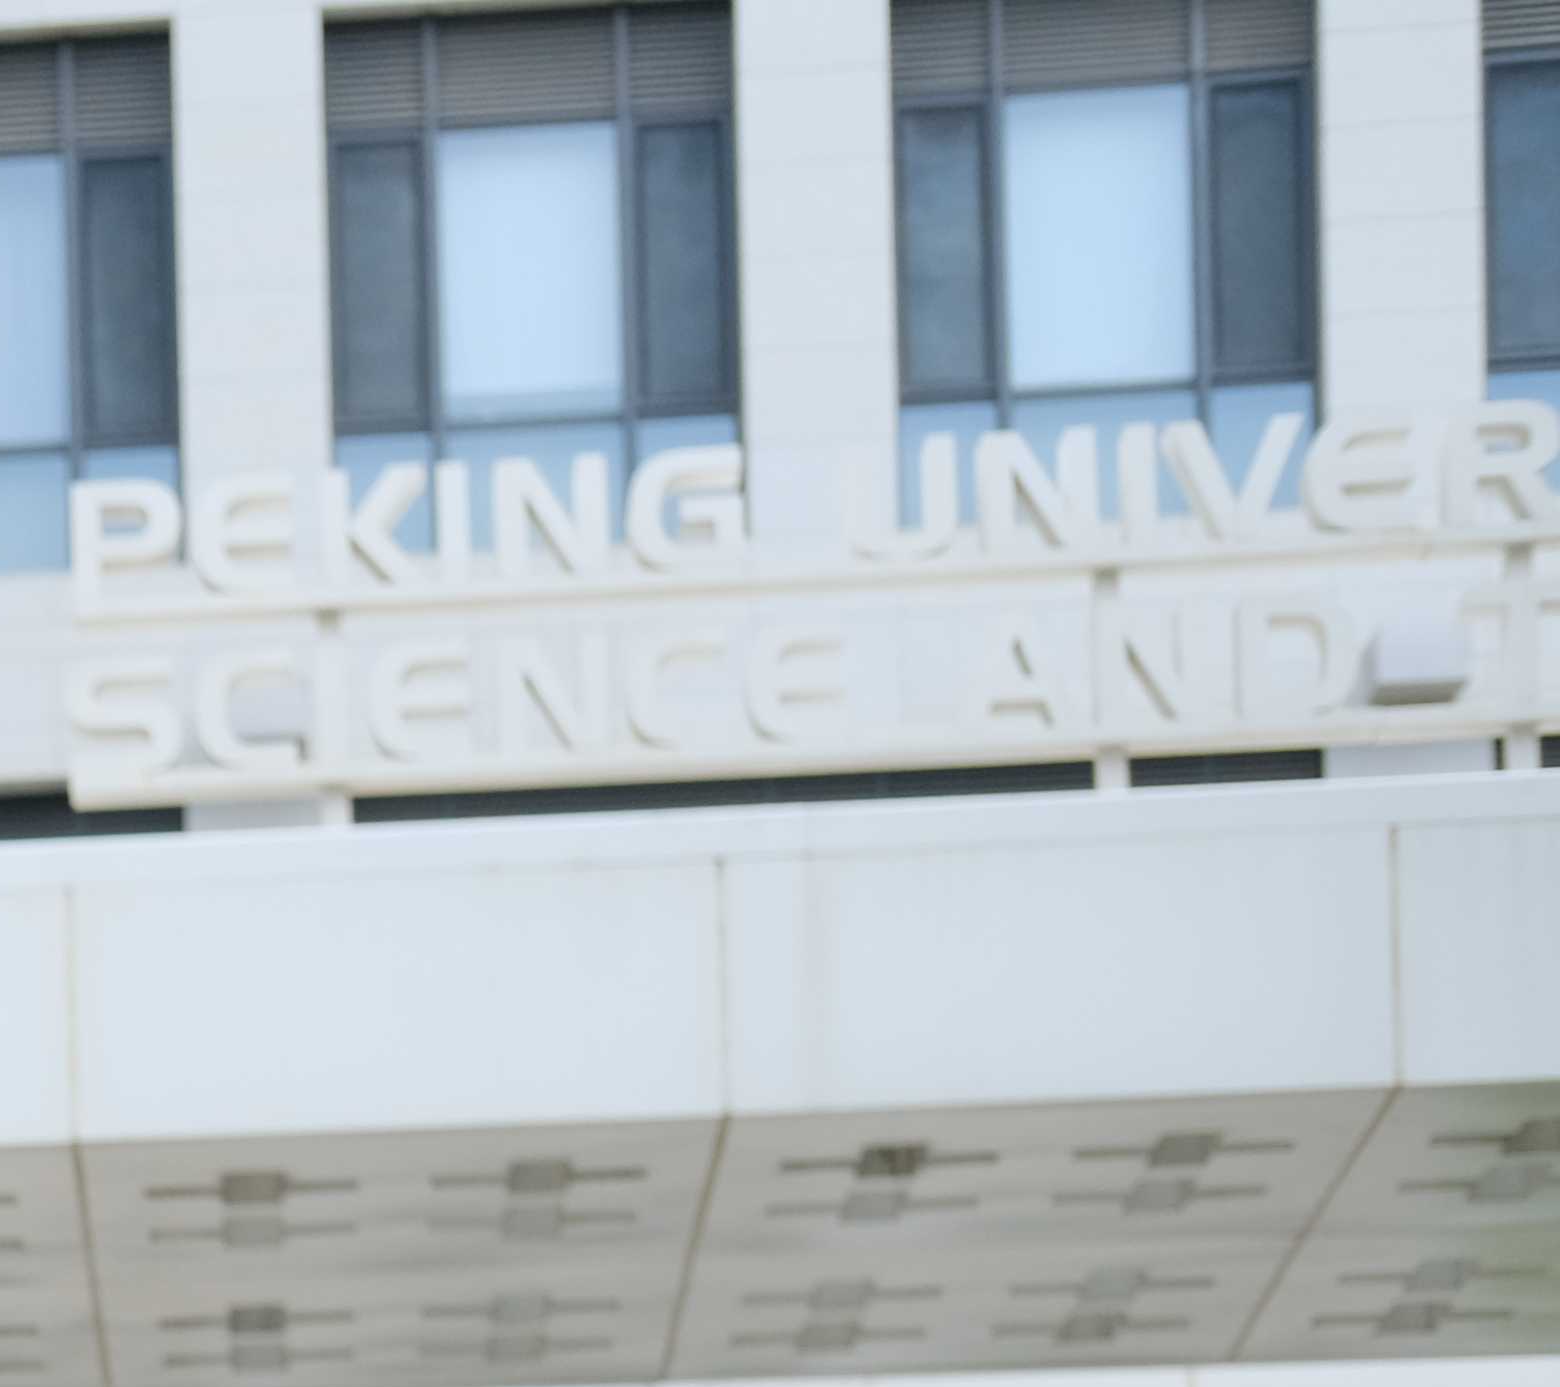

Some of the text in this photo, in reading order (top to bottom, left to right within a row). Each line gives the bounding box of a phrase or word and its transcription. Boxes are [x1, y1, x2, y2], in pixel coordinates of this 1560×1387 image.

[70, 398, 1560, 602] PEKING UNIVER
[66, 612, 850, 772] SCIENCE
[970, 596, 1360, 732] AND
